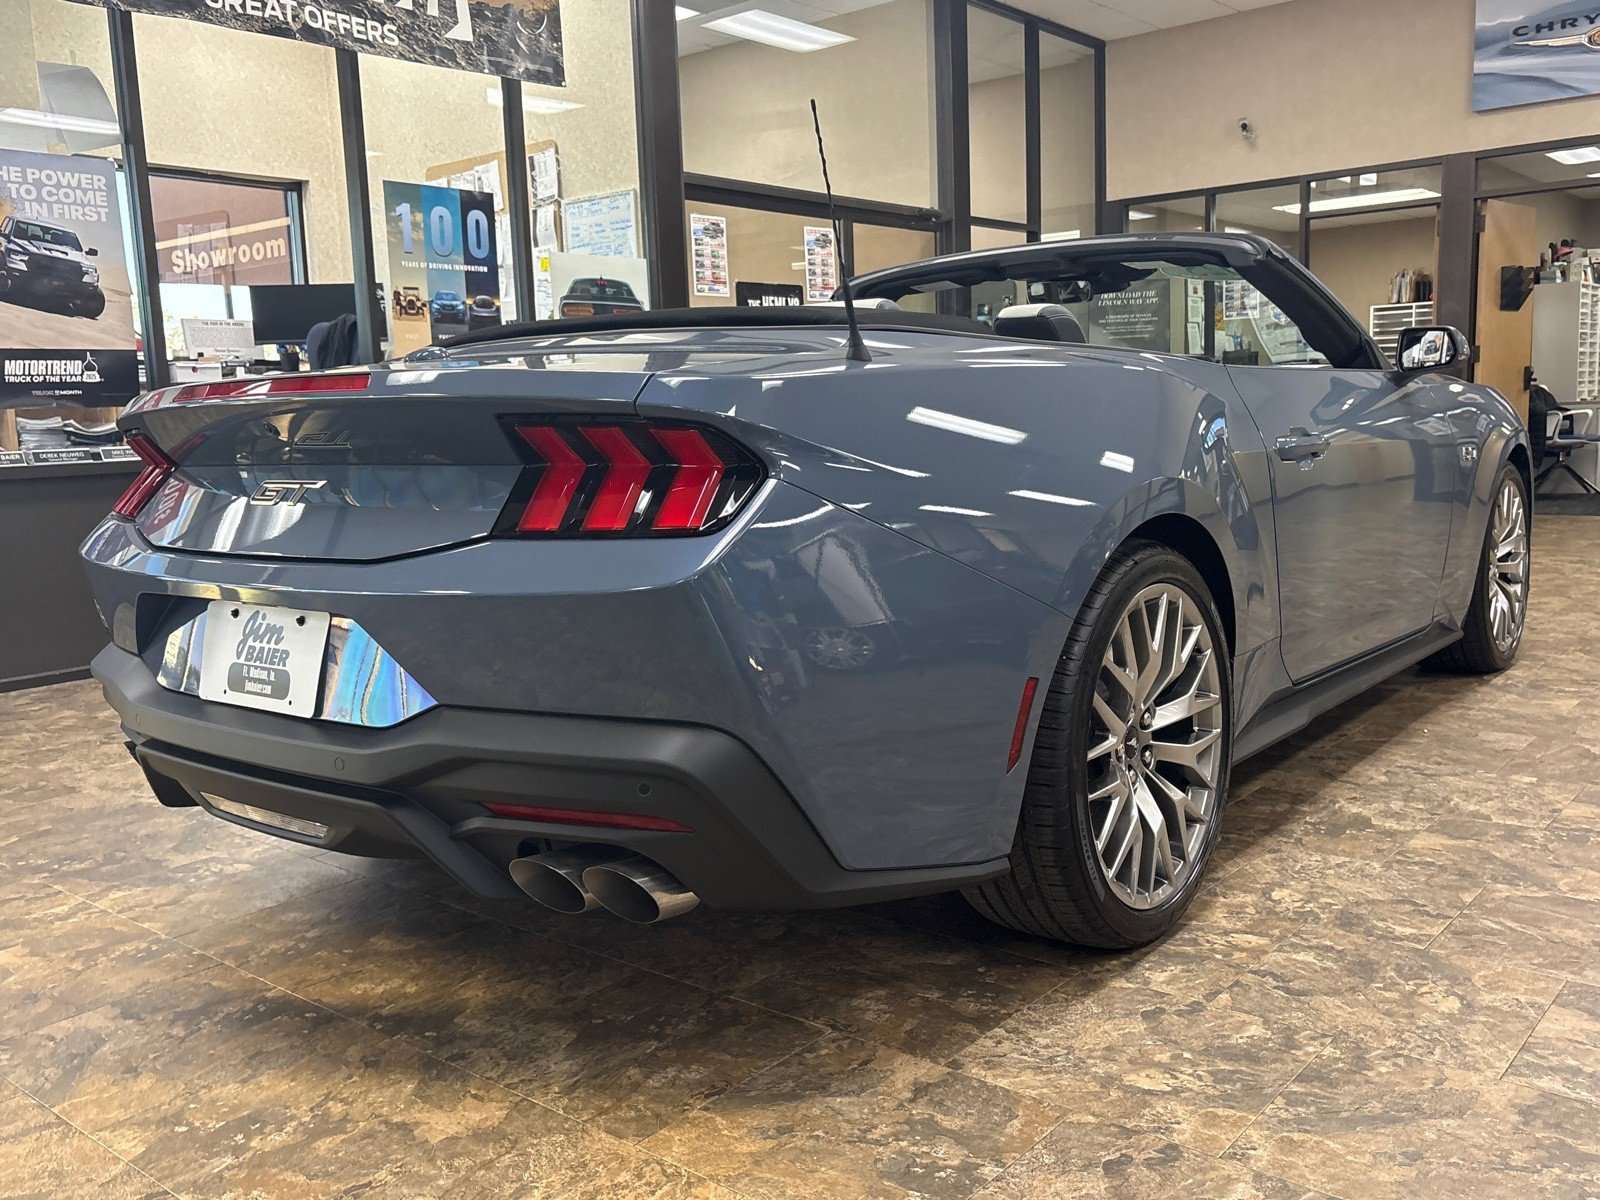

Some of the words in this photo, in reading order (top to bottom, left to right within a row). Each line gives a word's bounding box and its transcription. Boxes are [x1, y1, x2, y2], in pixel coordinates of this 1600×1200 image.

[304, 6, 399, 46] OFFERS
[26, 168, 107, 191] POWER
[7, 183, 37, 200] TO
[41, 186, 108, 206] COME
[24, 201, 49, 218] IN
[53, 203, 109, 222] FIRST
[171, 237, 286, 274] Showroom
[453, 264, 488, 272] INNOVATION
[1101, 291, 1141, 300] DOWNLOAD
[1142, 290, 1157, 298] THE
[4, 360, 82, 375] MOTORTREND
[4, 375, 32, 383] TRUCK
[32, 375, 44, 383] OF
[45, 375, 60, 383] THE
[61, 375, 82, 383] YEAR
[250, 480, 328, 506] GT
[236, 609, 285, 660] Jim
[244, 645, 290, 667] BAIER
